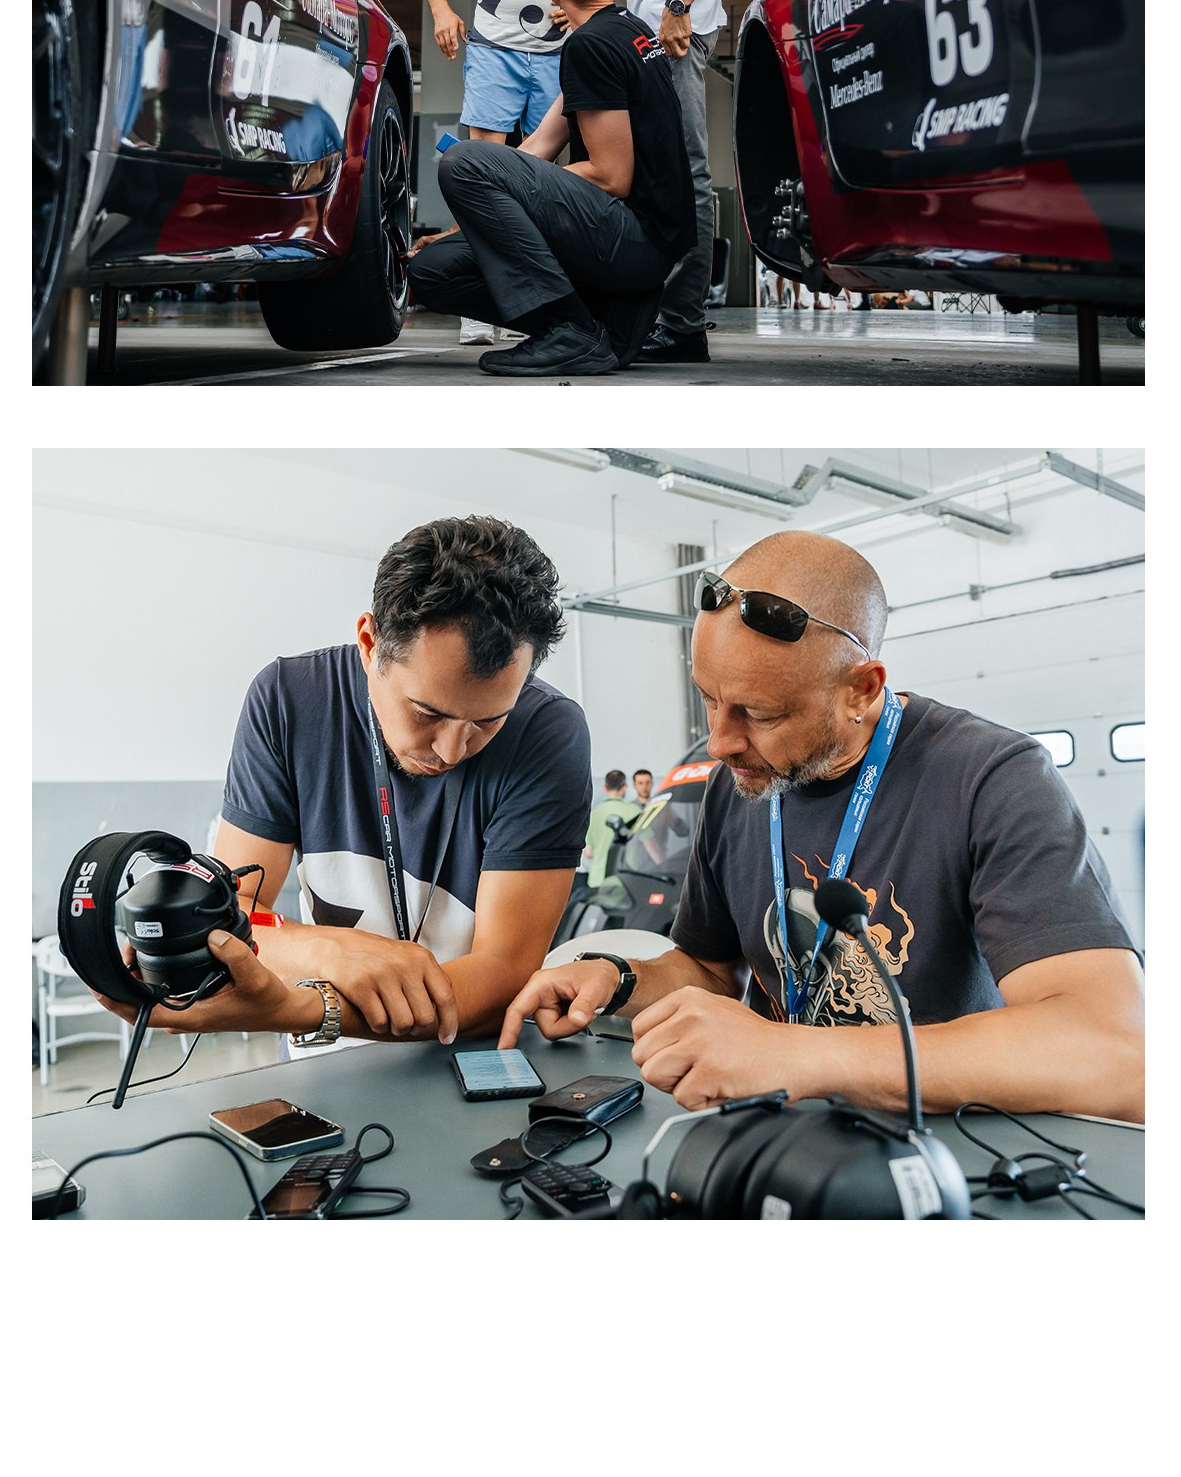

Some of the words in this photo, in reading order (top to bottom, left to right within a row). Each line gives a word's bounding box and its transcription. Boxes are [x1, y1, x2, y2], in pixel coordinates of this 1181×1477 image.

[233, 0, 281, 107] 61
[258, 127, 287, 154] RACING
[71, 862, 96, 917] Stilo
[380, 787, 392, 843] RSCAR
[387, 845, 406, 940] MOTORSPORT
